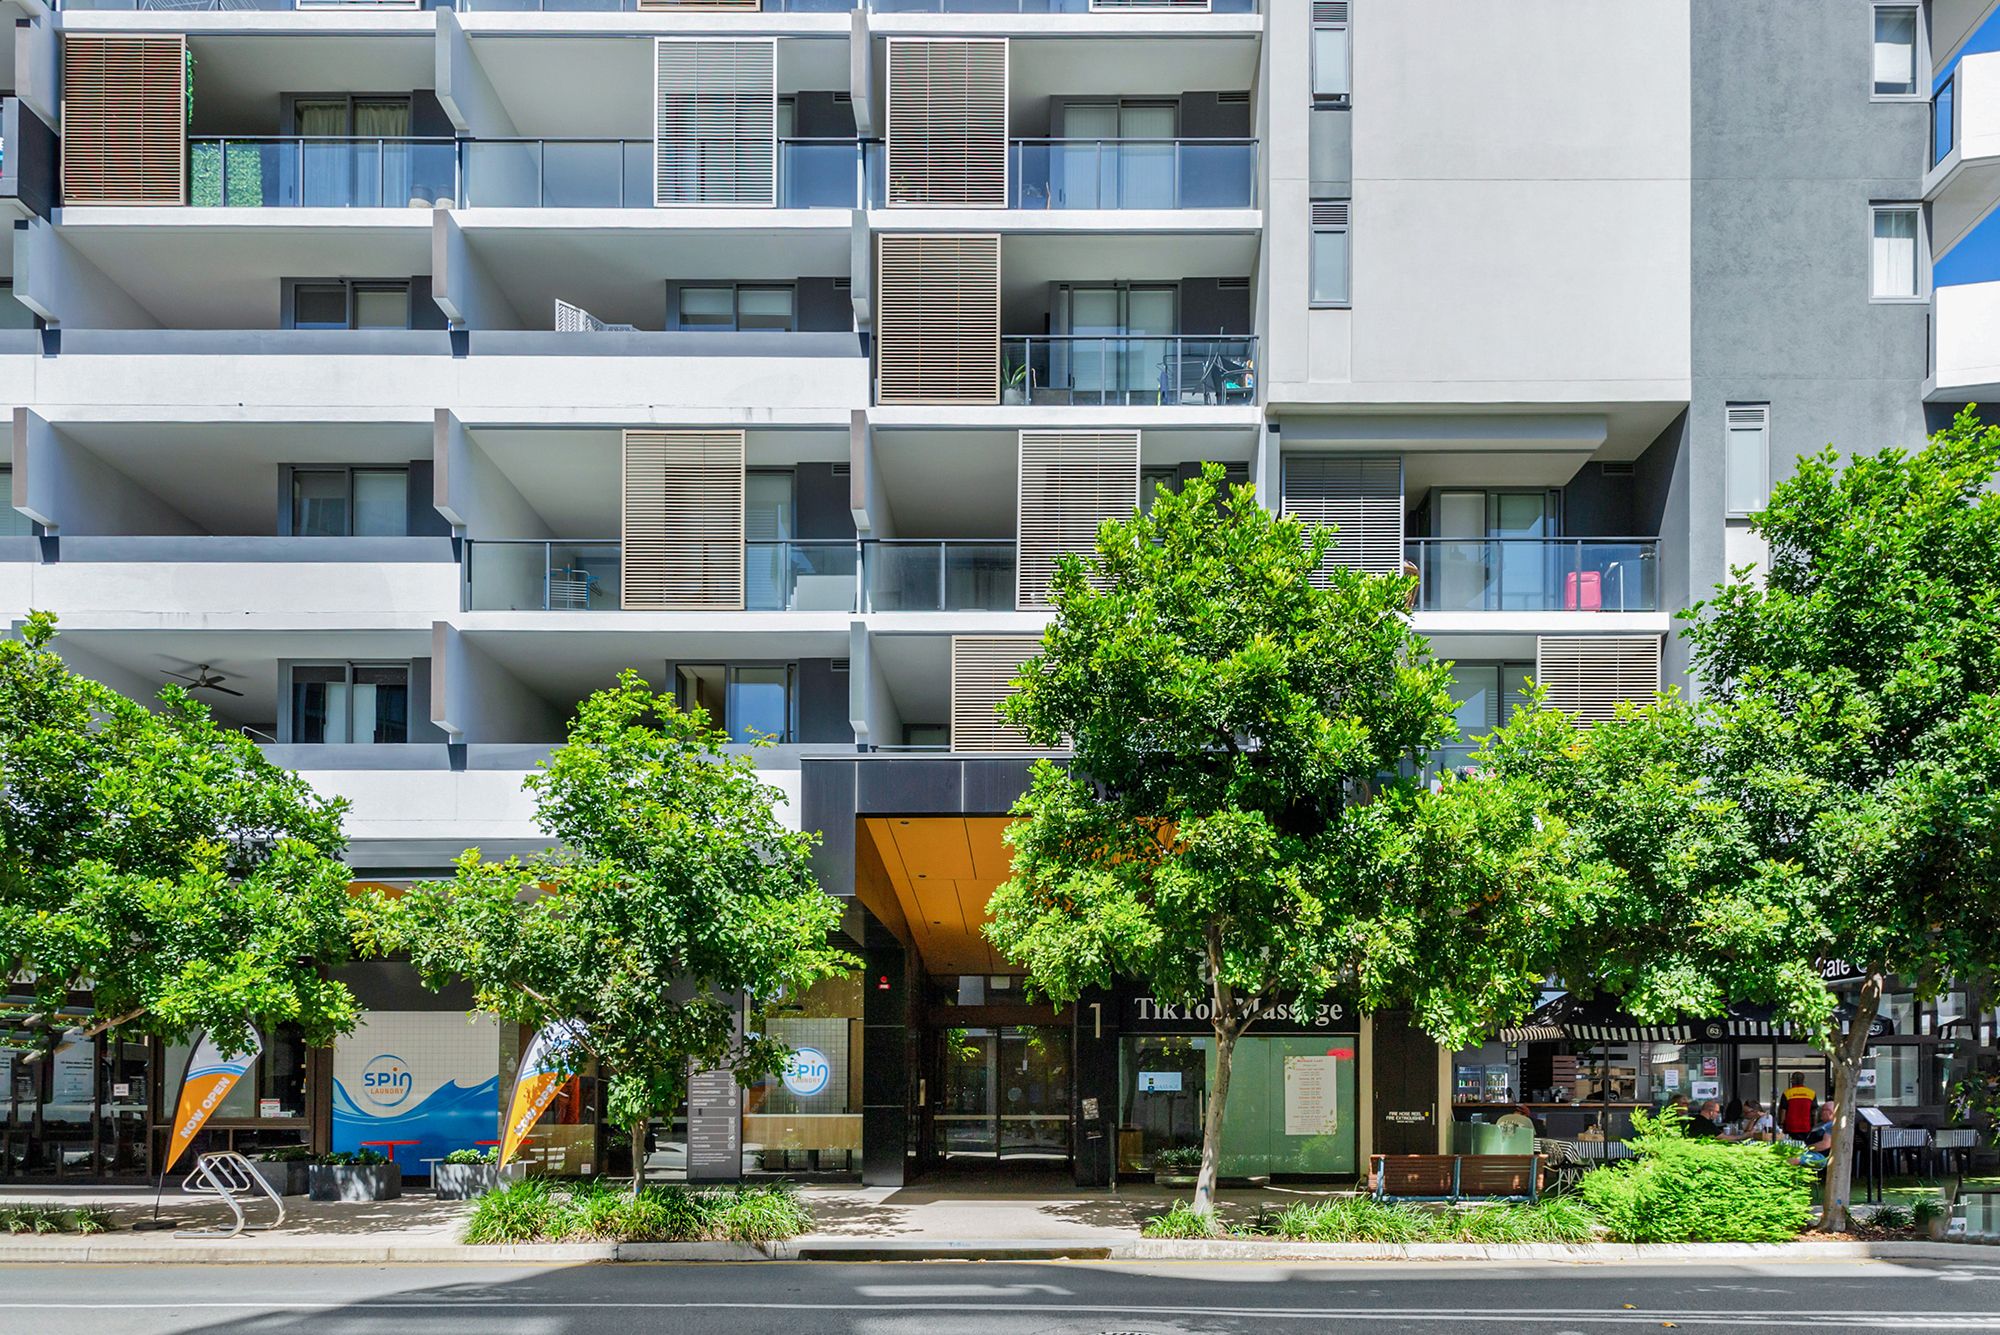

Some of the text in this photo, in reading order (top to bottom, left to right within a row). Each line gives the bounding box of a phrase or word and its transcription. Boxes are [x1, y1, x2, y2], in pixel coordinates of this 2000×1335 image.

[1088, 1002, 1101, 1039] 1
[1233, 997, 1343, 1027] Massge
[179, 1076, 231, 1139] NOW OPEN
